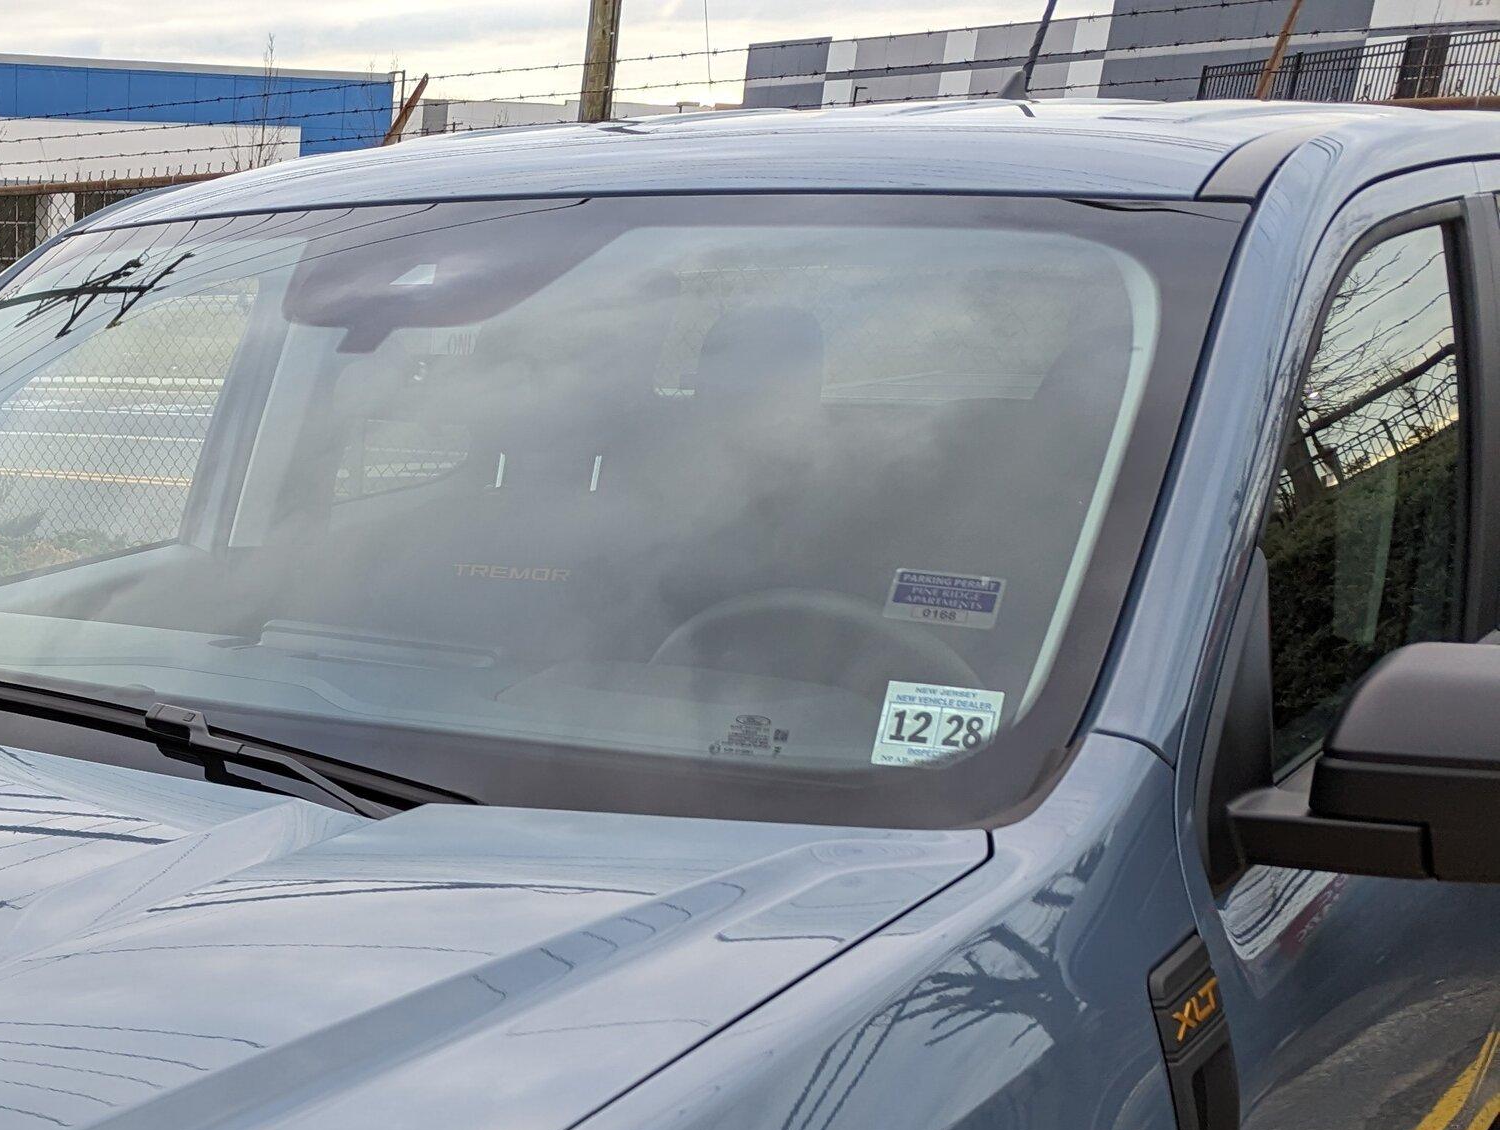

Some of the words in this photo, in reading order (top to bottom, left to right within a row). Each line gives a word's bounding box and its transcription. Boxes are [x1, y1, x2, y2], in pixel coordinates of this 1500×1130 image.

[452, 564, 571, 581] TREMOR
[902, 573, 953, 586] PARKING
[915, 686, 937, 694] NEW
[940, 688, 978, 698] JERSEY
[896, 694, 917, 702] NEW
[956, 699, 992, 710] DEALER
[889, 709, 933, 744] 12
[941, 714, 985, 749] 28
[1172, 977, 1218, 1041] XLT
